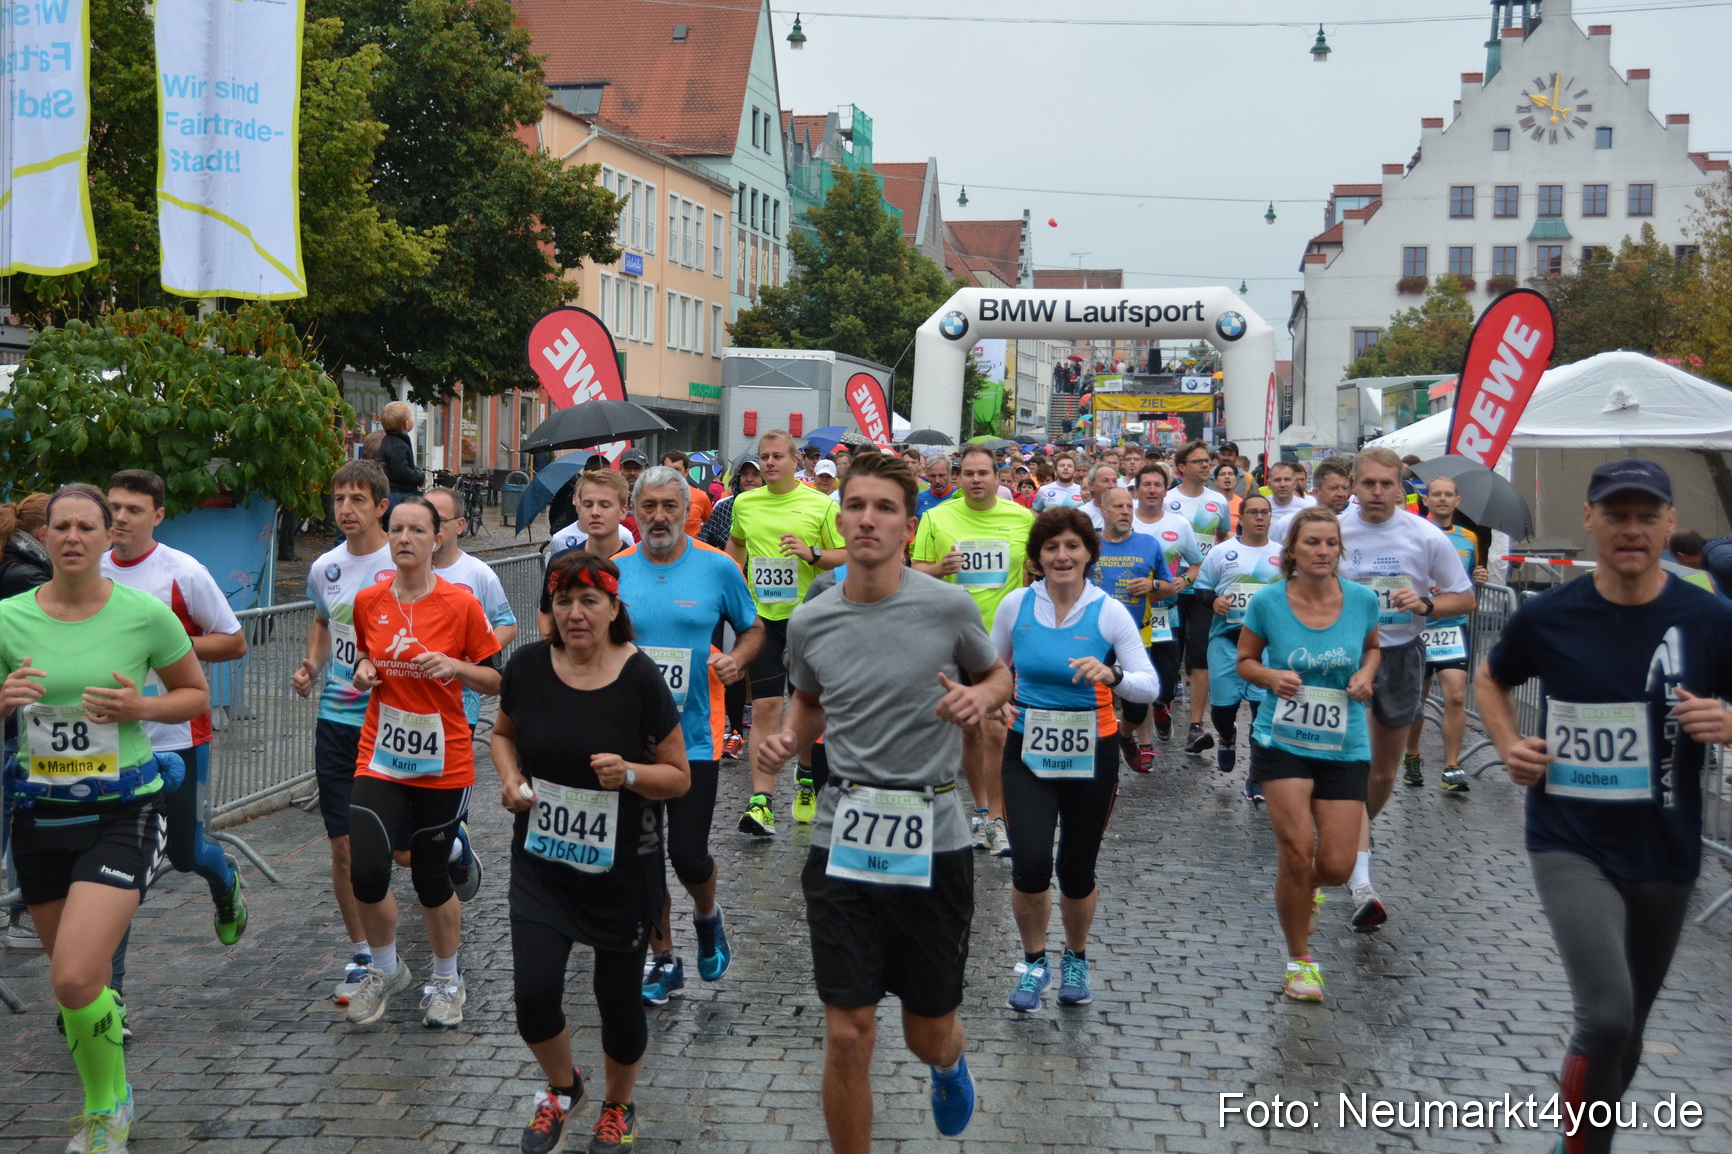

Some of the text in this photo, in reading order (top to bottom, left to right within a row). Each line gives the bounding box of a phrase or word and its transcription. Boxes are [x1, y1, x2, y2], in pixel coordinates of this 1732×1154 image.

[163, 73, 259, 105] Wir sind
[165, 111, 284, 142] Fairtrade-
[169, 148, 241, 173] Stadt!
[979, 298, 1205, 328] BMW Laufsport
[1457, 315, 1541, 467] REWE
[1140, 398, 1167, 409] ZIEL
[961, 551, 1003, 570] 3011
[1098, 555, 1144, 563] NEUMARKTER
[755, 568, 794, 585] 2333
[763, 589, 782, 597] Manu
[1422, 631, 1457, 648] 2427
[1287, 647, 1346, 674] Choose
[1430, 648, 1453, 656] Norbert
[1322, 656, 1353, 676] your
[1281, 700, 1340, 729] 2103
[1582, 706, 1635, 719] BOCK
[51, 721, 90, 752] 58
[381, 722, 438, 755] 2694
[1030, 725, 1089, 752] 2585
[1295, 729, 1320, 742] Petra
[1555, 725, 1638, 762] 2502
[48, 760, 93, 773] Martina
[392, 757, 417, 771] Karin
[1042, 758, 1073, 770] Margit
[1570, 769, 1618, 786] Jochen
[566, 790, 609, 804] BOCK
[537, 801, 608, 843] 3044
[842, 808, 923, 849] 2778
[531, 836, 600, 866] SIGRID
[867, 855, 889, 871] Nic
